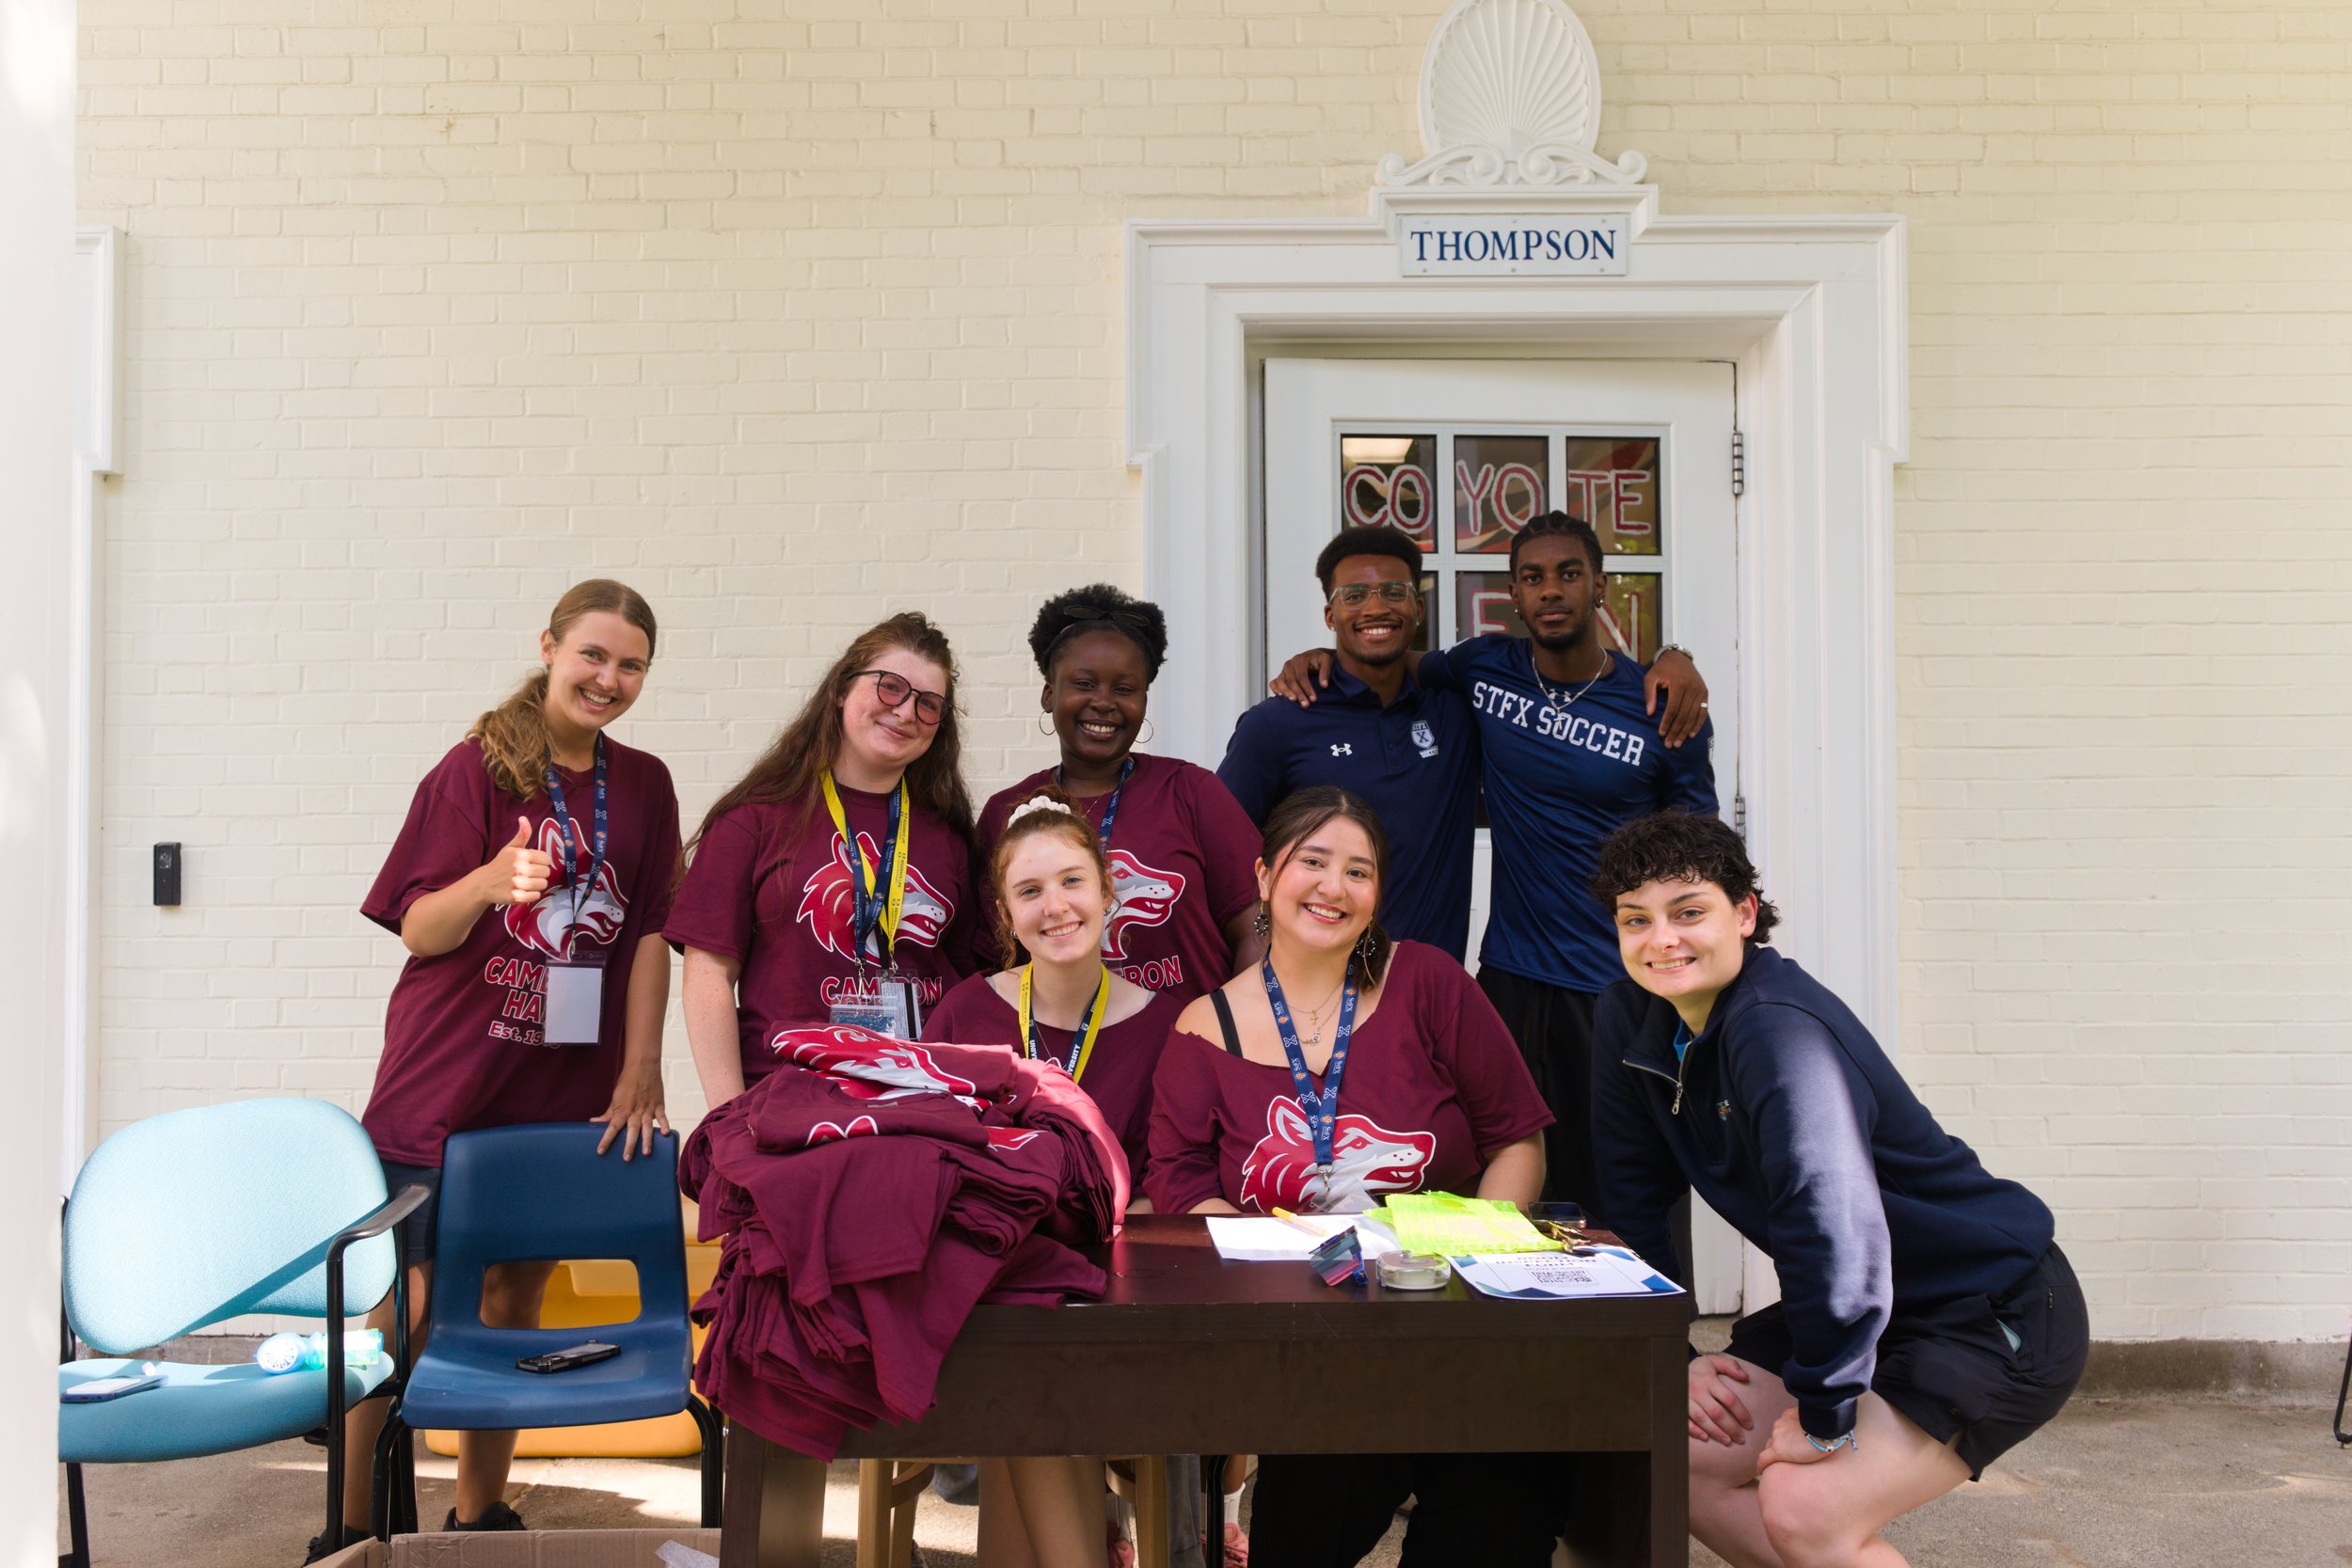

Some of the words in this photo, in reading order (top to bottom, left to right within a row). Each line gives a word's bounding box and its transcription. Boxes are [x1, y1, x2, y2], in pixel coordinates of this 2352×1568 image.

[1410, 229, 1617, 261] THOMPSON
[1471, 680, 1534, 730] STFX
[1535, 705, 1646, 767] SOCCER
[501, 989, 546, 1024] HA
[488, 1021, 522, 1042] Est.
